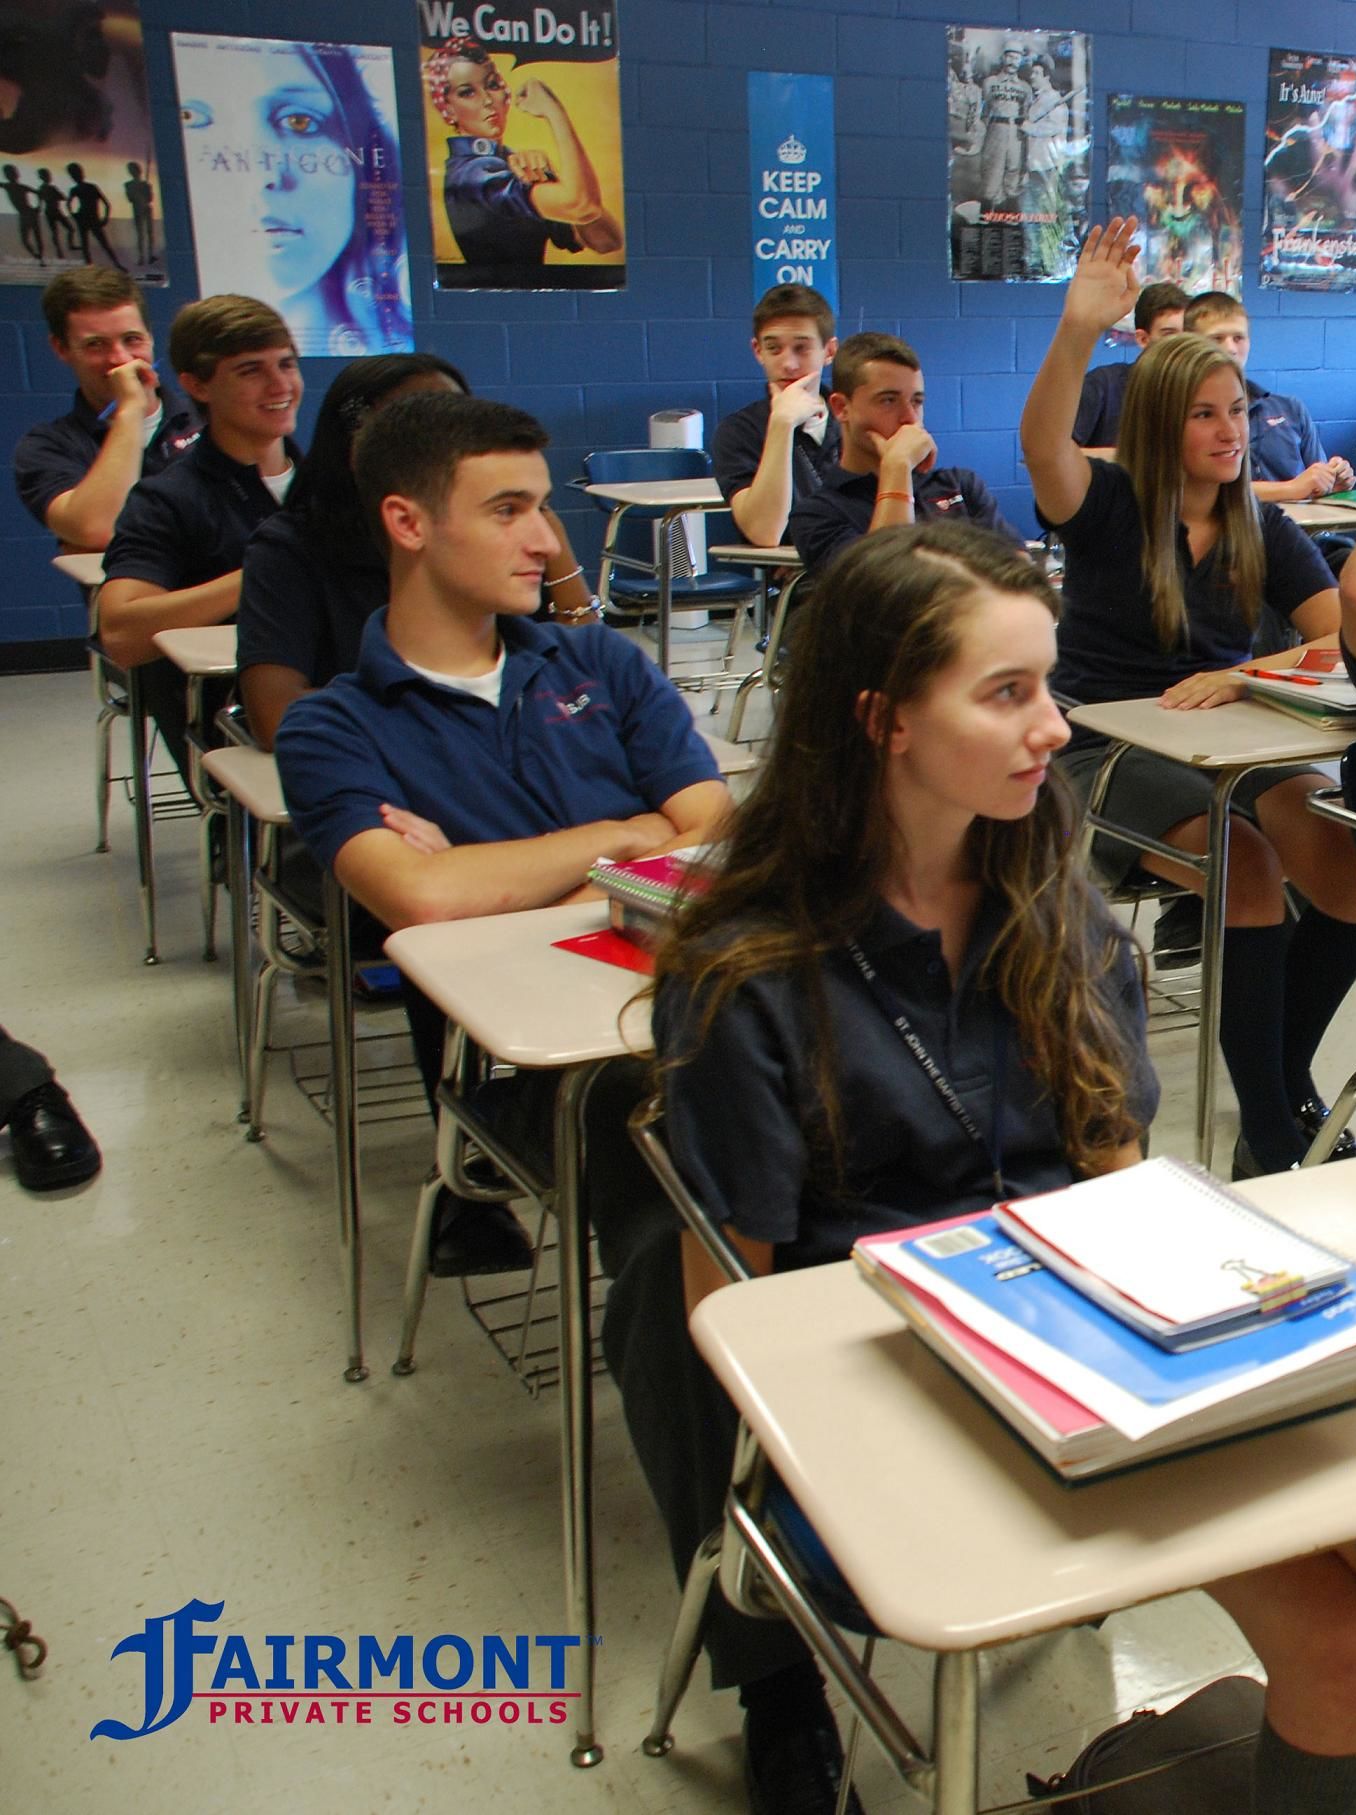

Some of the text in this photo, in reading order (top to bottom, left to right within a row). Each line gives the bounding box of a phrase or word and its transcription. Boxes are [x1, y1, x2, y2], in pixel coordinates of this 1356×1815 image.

[419, 0, 613, 47] We Can Do It!
[211, 147, 387, 176] ANTIGONE
[762, 170, 822, 193] KEEP
[759, 197, 828, 220] CALM
[783, 224, 806, 235] AND
[755, 237, 832, 261] CARRY
[776, 265, 814, 287] ON
[904, 1033, 928, 1060] JOHN
[922, 1057, 941, 1079] THE
